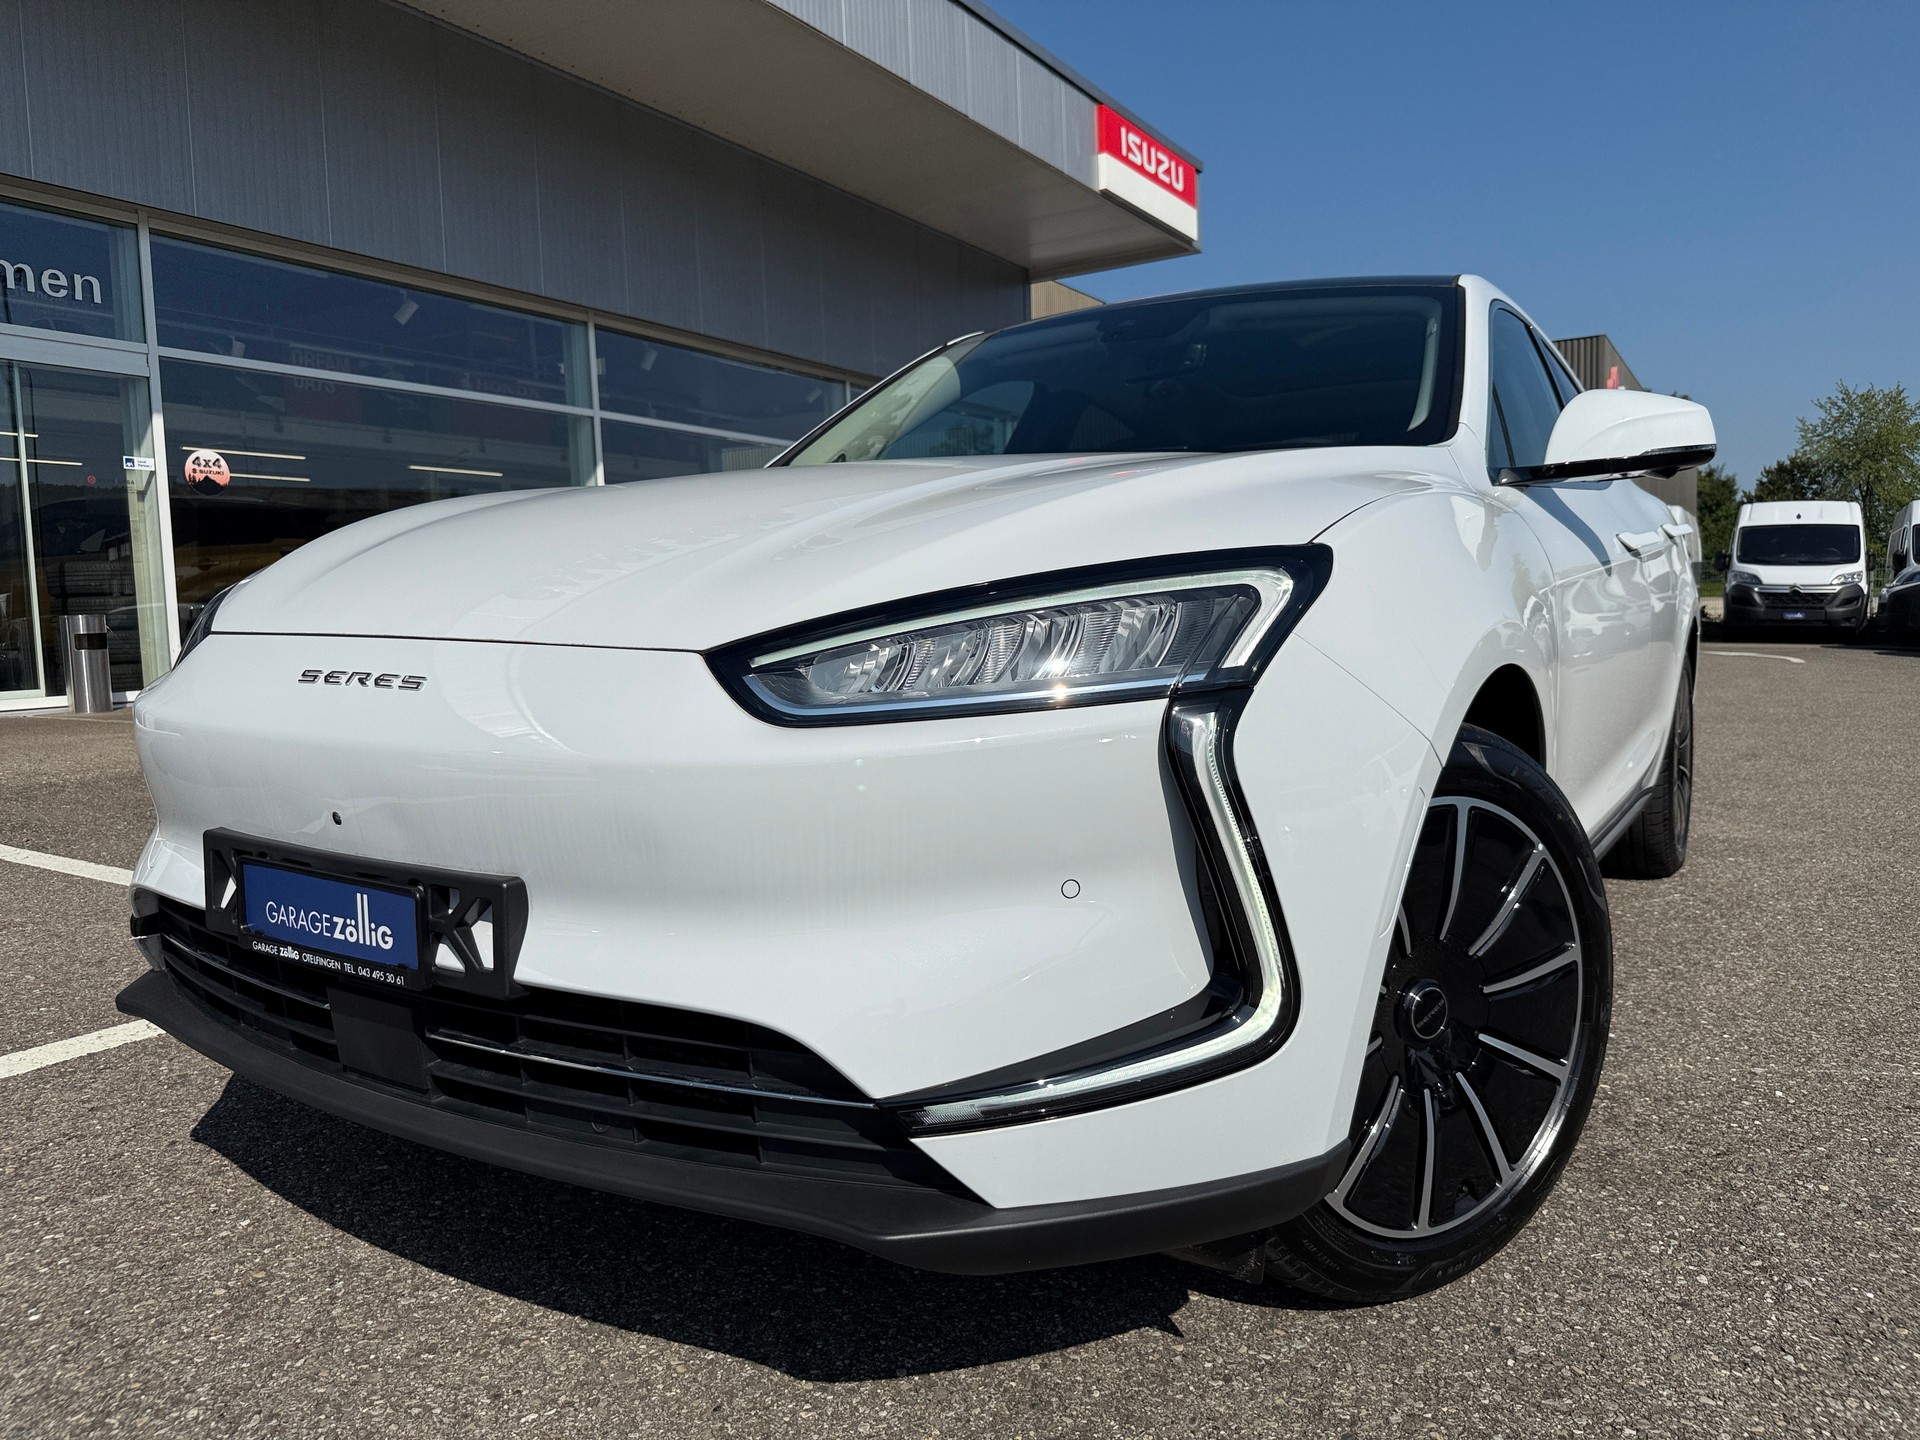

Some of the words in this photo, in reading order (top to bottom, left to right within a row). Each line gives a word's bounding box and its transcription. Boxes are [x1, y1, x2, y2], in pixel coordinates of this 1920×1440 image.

[1120, 125, 1185, 193] ISUZU
[0, 259, 102, 304] men
[192, 456, 222, 469] 4x4
[298, 669, 428, 691] SERES
[252, 940, 279, 955] GARAGE
[302, 953, 341, 971] OTELFINGEN
[357, 966, 371, 978] 043
[372, 969, 385, 981] 495
[386, 972, 395, 984] 30
[396, 975, 405, 986] 61
